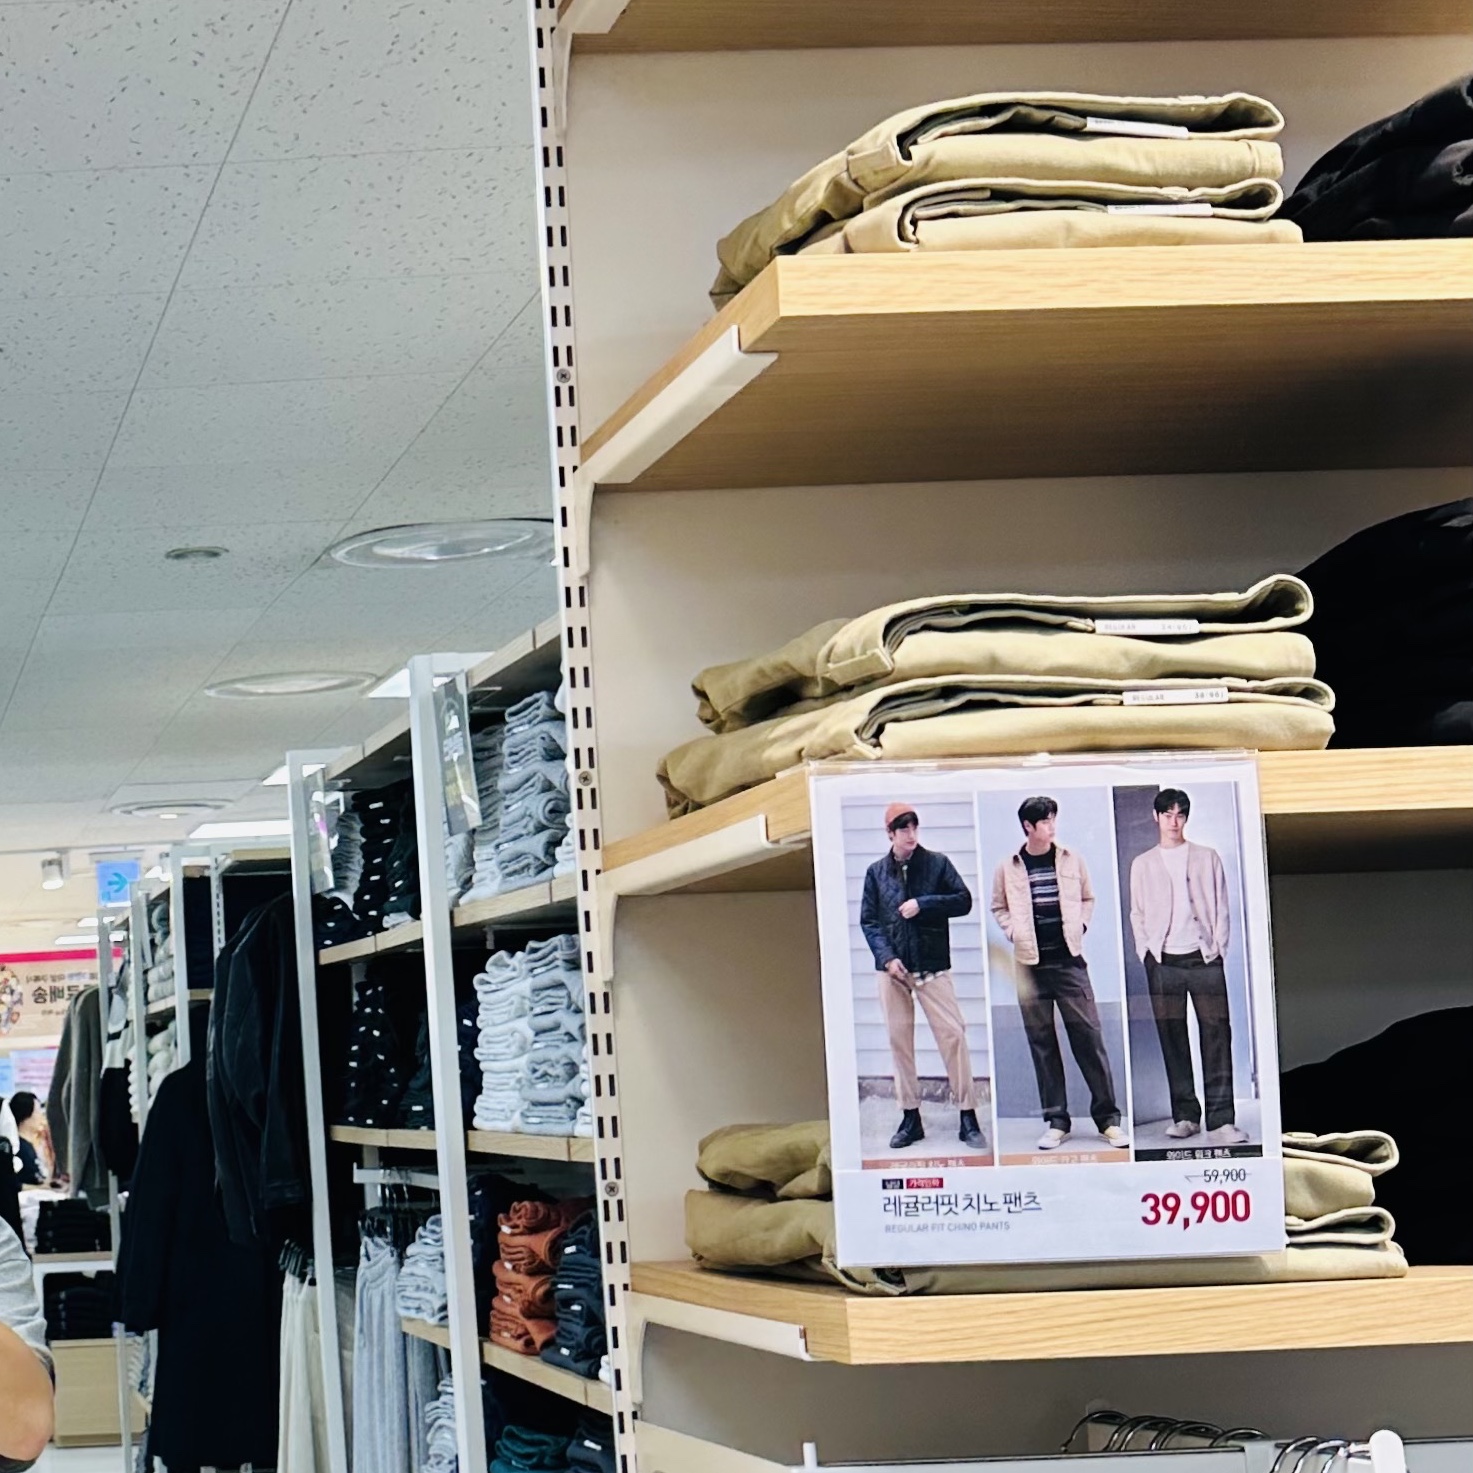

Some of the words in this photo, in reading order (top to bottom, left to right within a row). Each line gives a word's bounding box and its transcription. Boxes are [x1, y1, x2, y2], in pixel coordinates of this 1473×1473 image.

[1203, 1168, 1246, 1185] 59,900
[882, 1194, 959, 1217] 레귤러핏
[962, 1192, 1001, 1215] 치노
[1003, 1191, 1043, 1214] 팬츠
[1140, 1189, 1251, 1231] 39,900
[884, 1223, 929, 1233] REGULAR
[930, 1222, 945, 1232] FIT
[947, 1221, 978, 1232] CHINO
[979, 1220, 1011, 1231] PANTS
